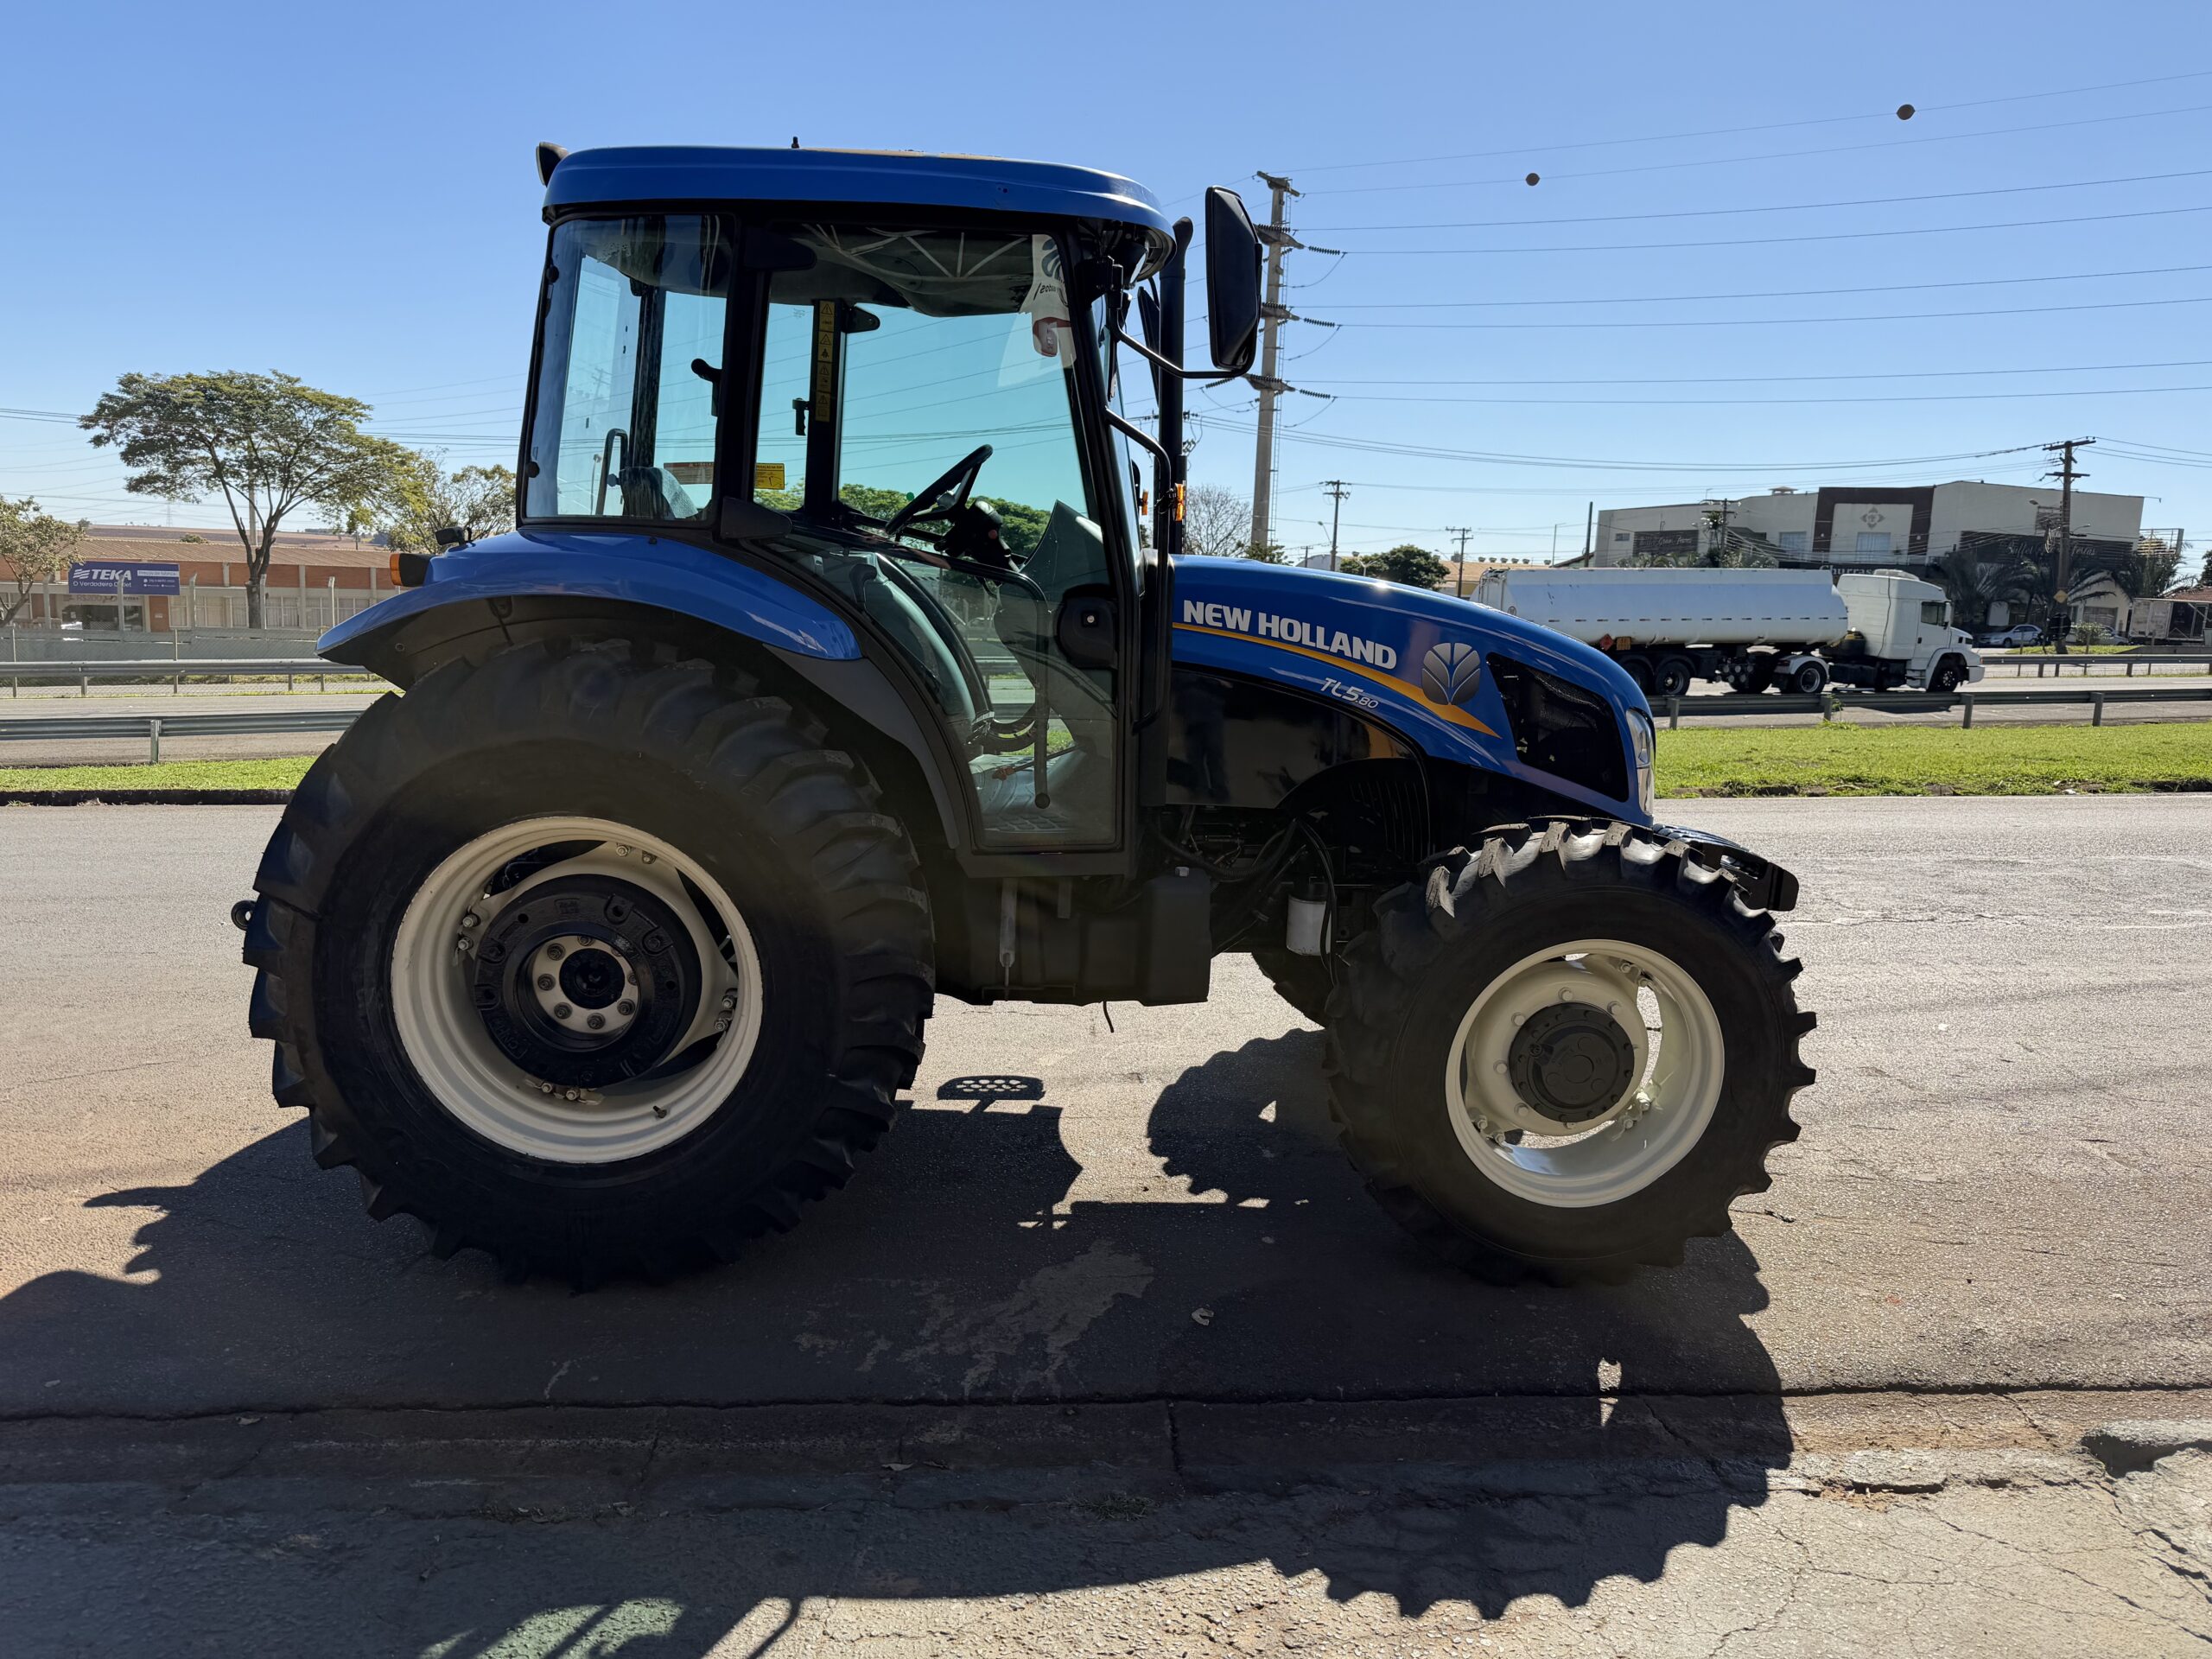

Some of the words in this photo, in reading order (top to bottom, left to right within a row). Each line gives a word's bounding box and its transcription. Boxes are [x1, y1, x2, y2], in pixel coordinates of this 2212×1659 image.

[92, 569, 131, 581] TEKA
[1819, 564, 1873, 575] Churras
[1183, 599, 1252, 632] NEW
[1258, 612, 1397, 670] HOLLAND
[1319, 677, 1379, 709] TL5.80
